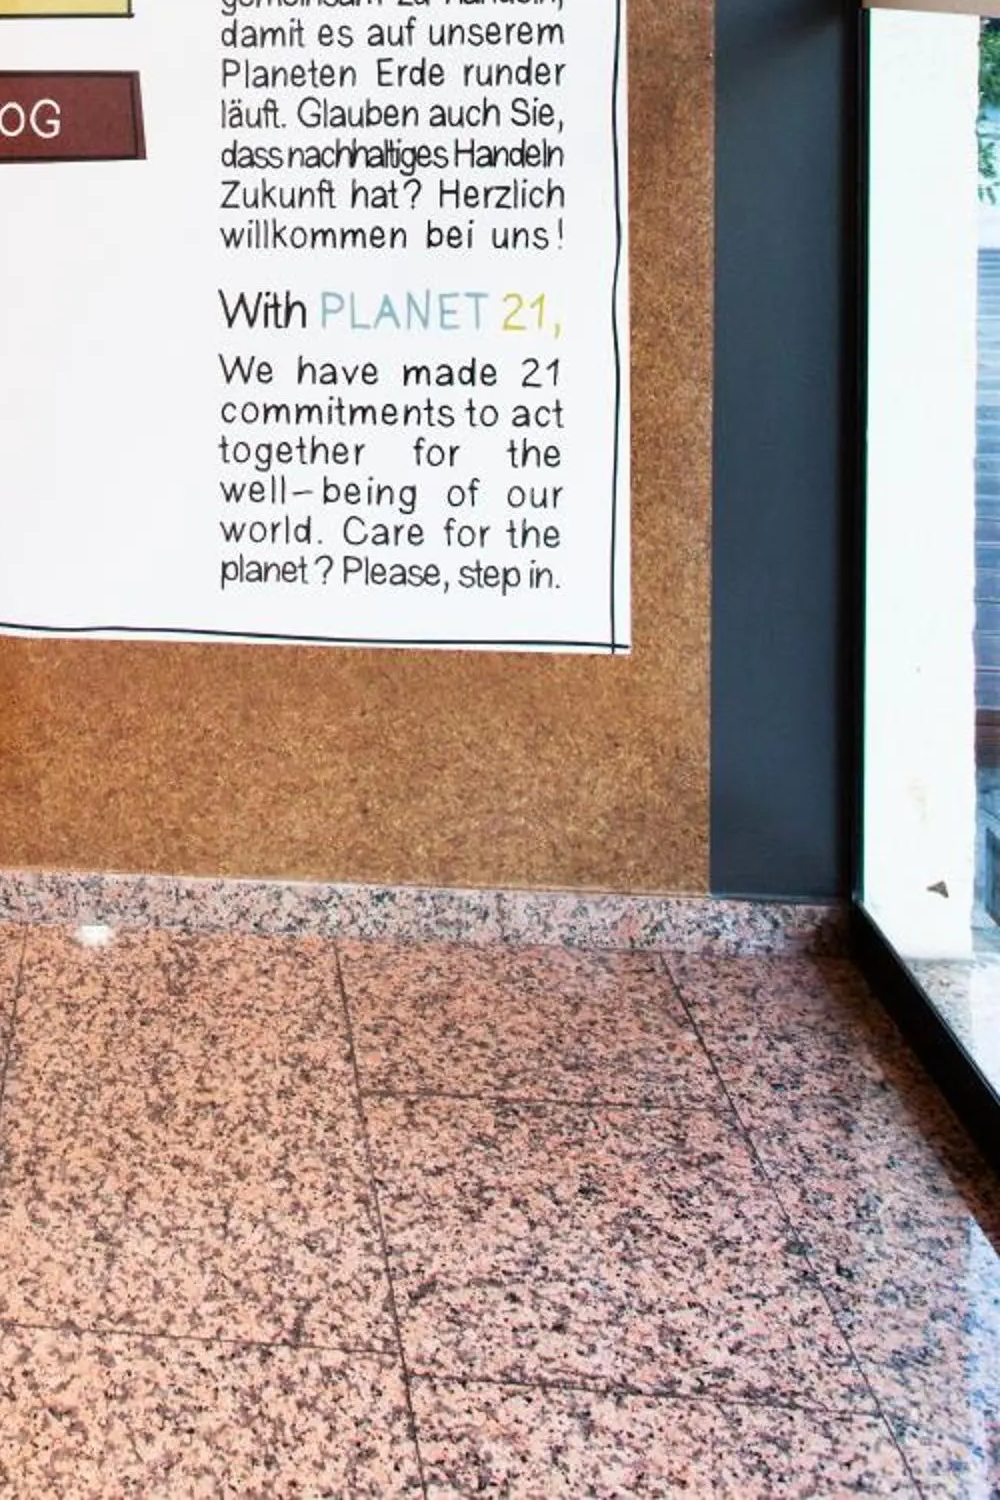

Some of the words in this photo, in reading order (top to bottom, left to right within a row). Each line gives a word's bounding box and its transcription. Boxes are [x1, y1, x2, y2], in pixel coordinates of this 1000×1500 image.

[221, 18, 305, 48] damit
[317, 22, 354, 46] es
[367, 17, 416, 46] auf
[429, 21, 565, 46] unserem
[221, 58, 357, 88] Planeten
[377, 57, 445, 87] Erde
[463, 56, 566, 87] runder
[221, 98, 286, 129] läuft.
[297, 96, 419, 129] Glauben
[429, 97, 501, 128] auch
[511, 96, 564, 133] Sie,
[221, 140, 284, 169] dass
[288, 138, 449, 176] nachhaltiges
[455, 138, 564, 168] Handeln
[220, 178, 336, 209] Zukunft
[439, 178, 566, 209] Herzlich
[220, 219, 407, 250] willkommen
[426, 218, 474, 249] bei
[218, 289, 308, 329] With
[321, 289, 489, 330] PLANET
[502, 292, 561, 338] 21,
[218, 354, 274, 385] We
[298, 356, 379, 386] have
[403, 358, 498, 387] made
[521, 358, 560, 388] 21
[221, 396, 456, 428] commitments
[465, 399, 499, 427] to
[512, 399, 565, 428] act
[218, 435, 365, 472] together
[413, 437, 461, 466] for
[506, 438, 561, 468] the
[447, 478, 480, 508] of
[508, 483, 563, 509] our
[219, 515, 323, 545] world.
[343, 516, 425, 546] Care
[444, 518, 491, 548] for
[506, 518, 561, 548] the
[343, 556, 450, 594] Please,
[458, 559, 521, 596] step
[529, 559, 561, 589] in.
